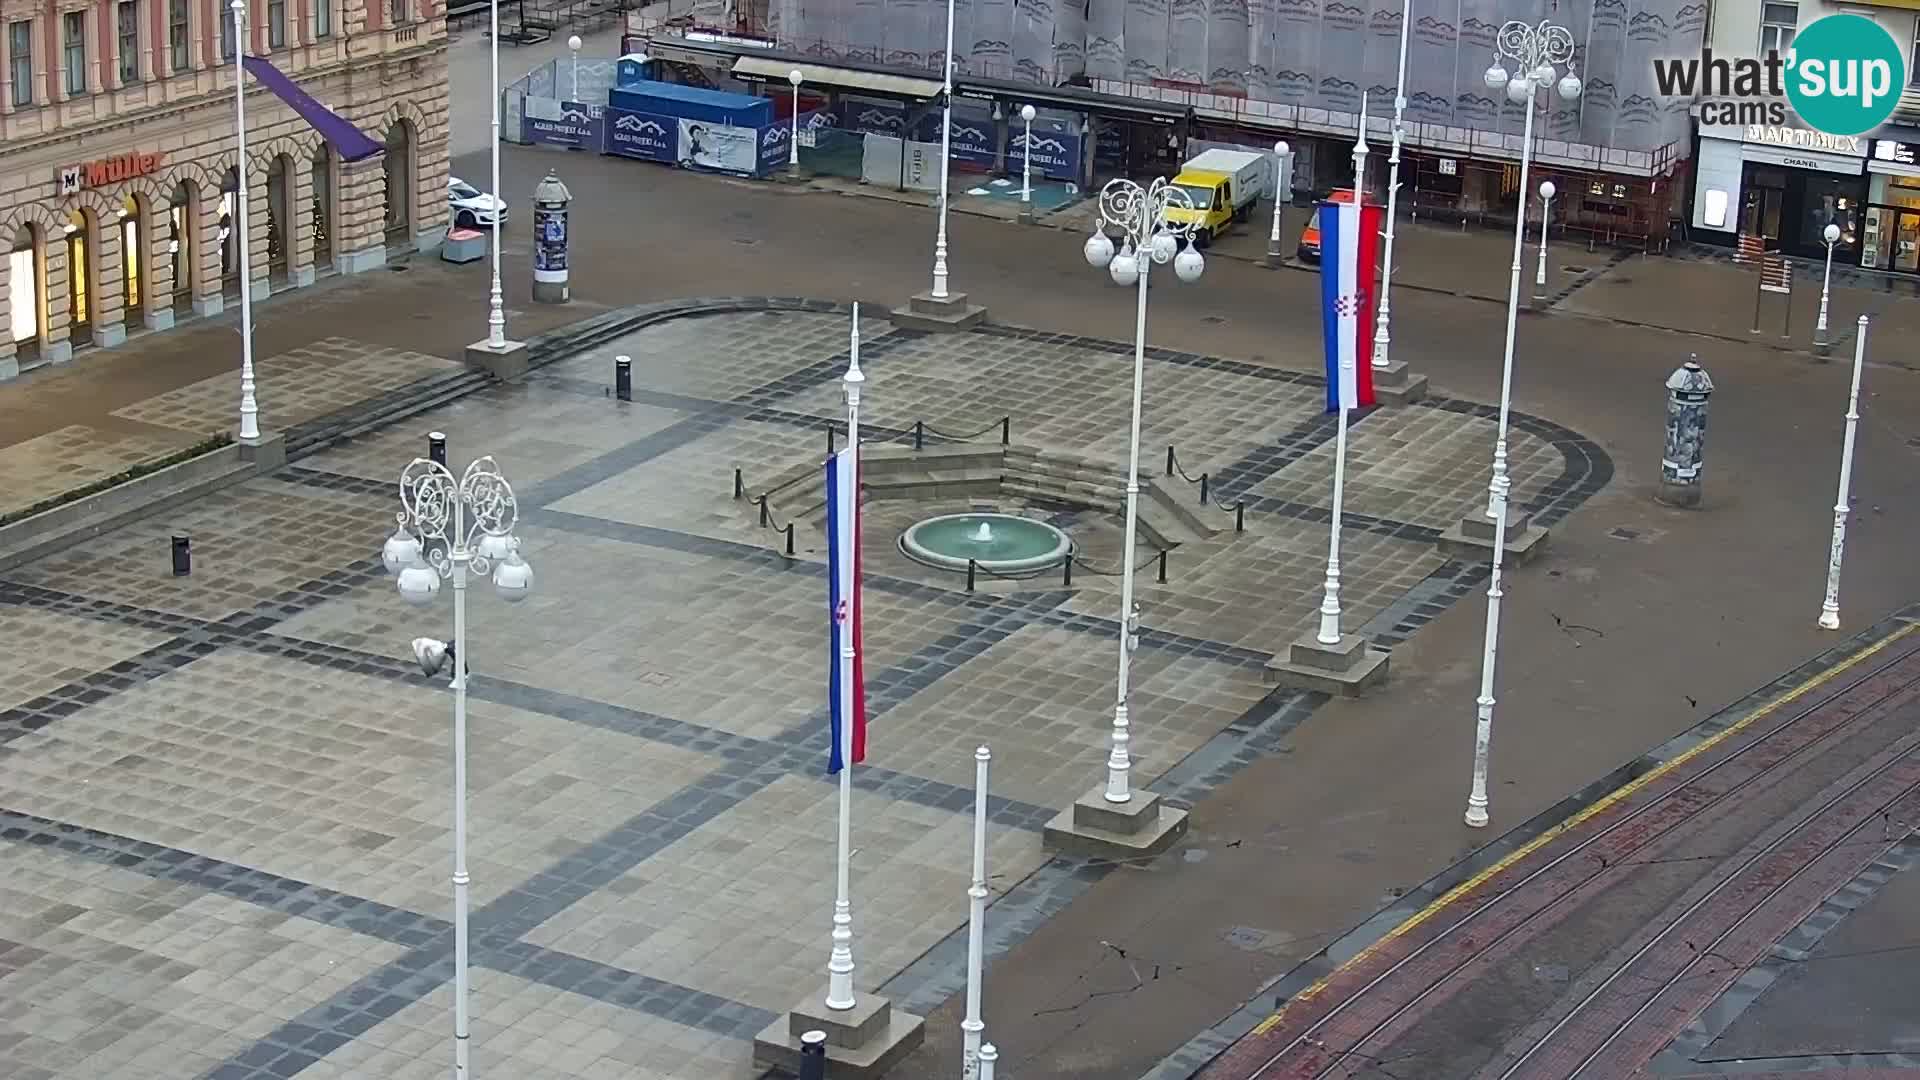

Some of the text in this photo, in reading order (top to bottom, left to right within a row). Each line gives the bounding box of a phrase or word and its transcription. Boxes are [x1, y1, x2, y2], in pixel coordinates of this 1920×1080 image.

[1748, 125, 1859, 152] MARTIMEX
[85, 150, 165, 186] Müller
[1783, 158, 1819, 168] CHANEL
